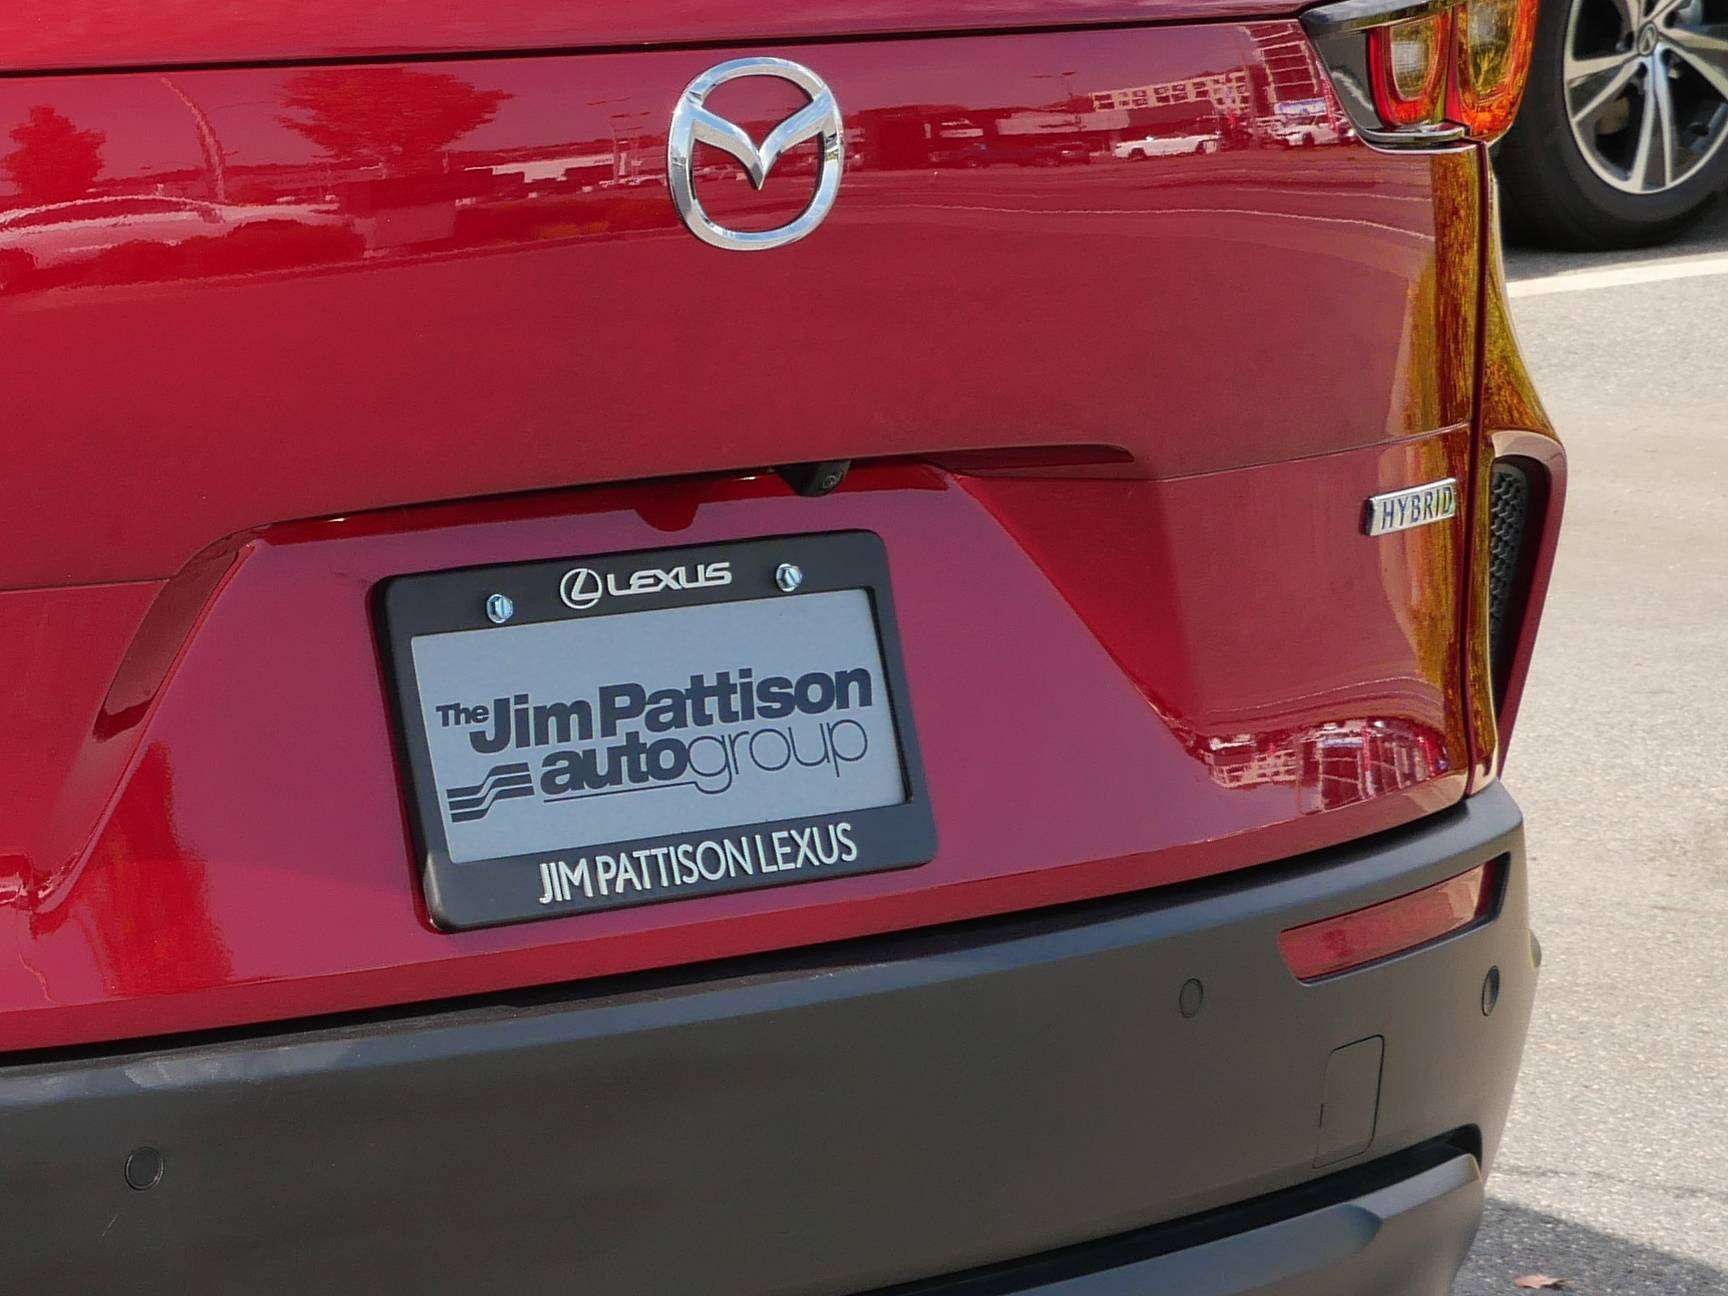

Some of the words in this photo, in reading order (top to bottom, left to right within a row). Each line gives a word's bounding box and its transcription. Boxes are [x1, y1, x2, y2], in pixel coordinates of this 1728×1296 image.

[1381, 486, 1454, 530] HYBRID
[605, 561, 733, 597] LEXUS
[436, 702, 491, 729] The
[538, 859, 594, 905] JIM
[597, 836, 754, 898] PATTISON
[757, 822, 858, 872] LEXUS
